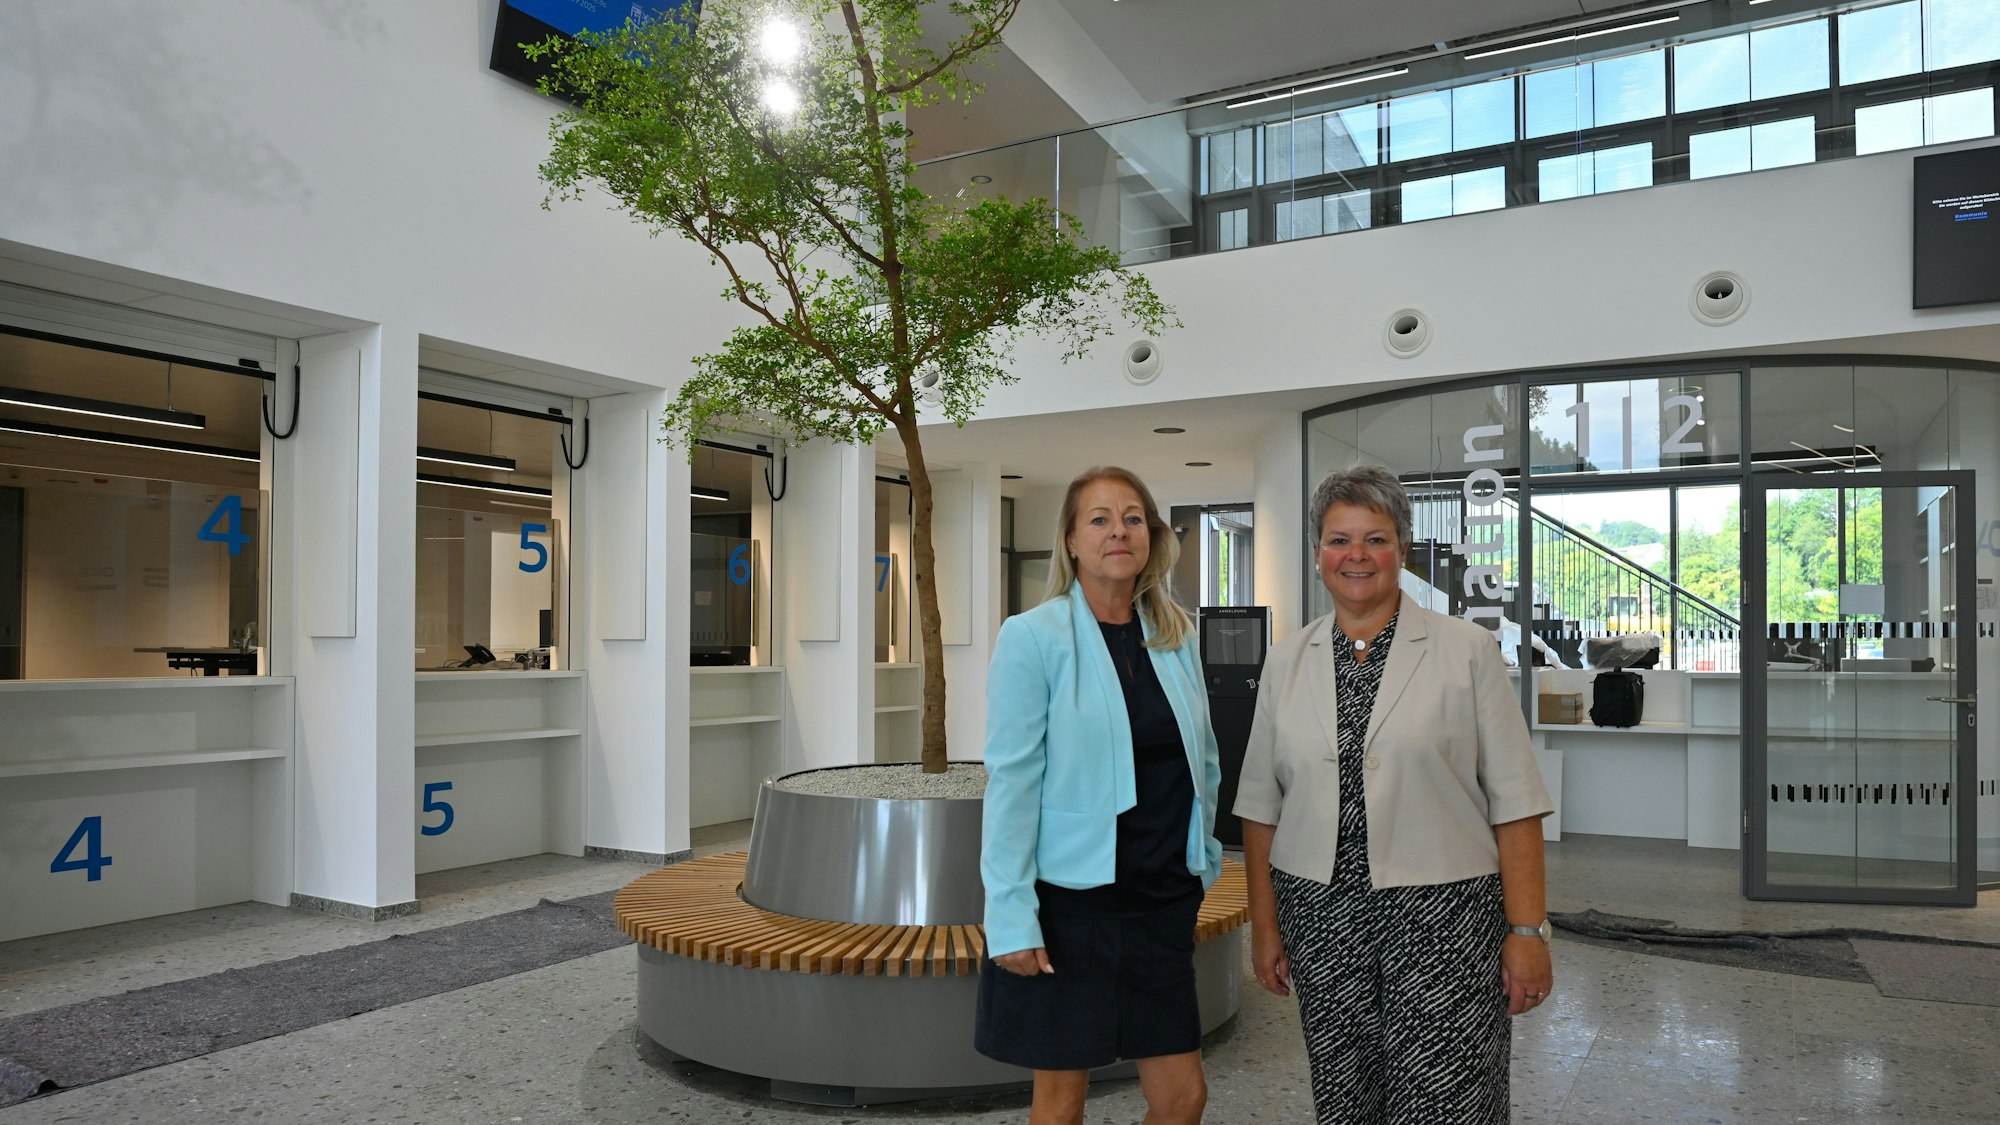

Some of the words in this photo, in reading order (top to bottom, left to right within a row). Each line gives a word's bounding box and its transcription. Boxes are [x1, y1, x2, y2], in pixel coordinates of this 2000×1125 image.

[1565, 402, 1590, 457] 1
[1662, 395, 1704, 454] 2
[196, 495, 250, 556] 4
[518, 522, 548, 573] 5
[728, 544, 751, 586] 6
[875, 556, 890, 592] 7
[420, 780, 455, 836] 5
[50, 816, 112, 882] 4
